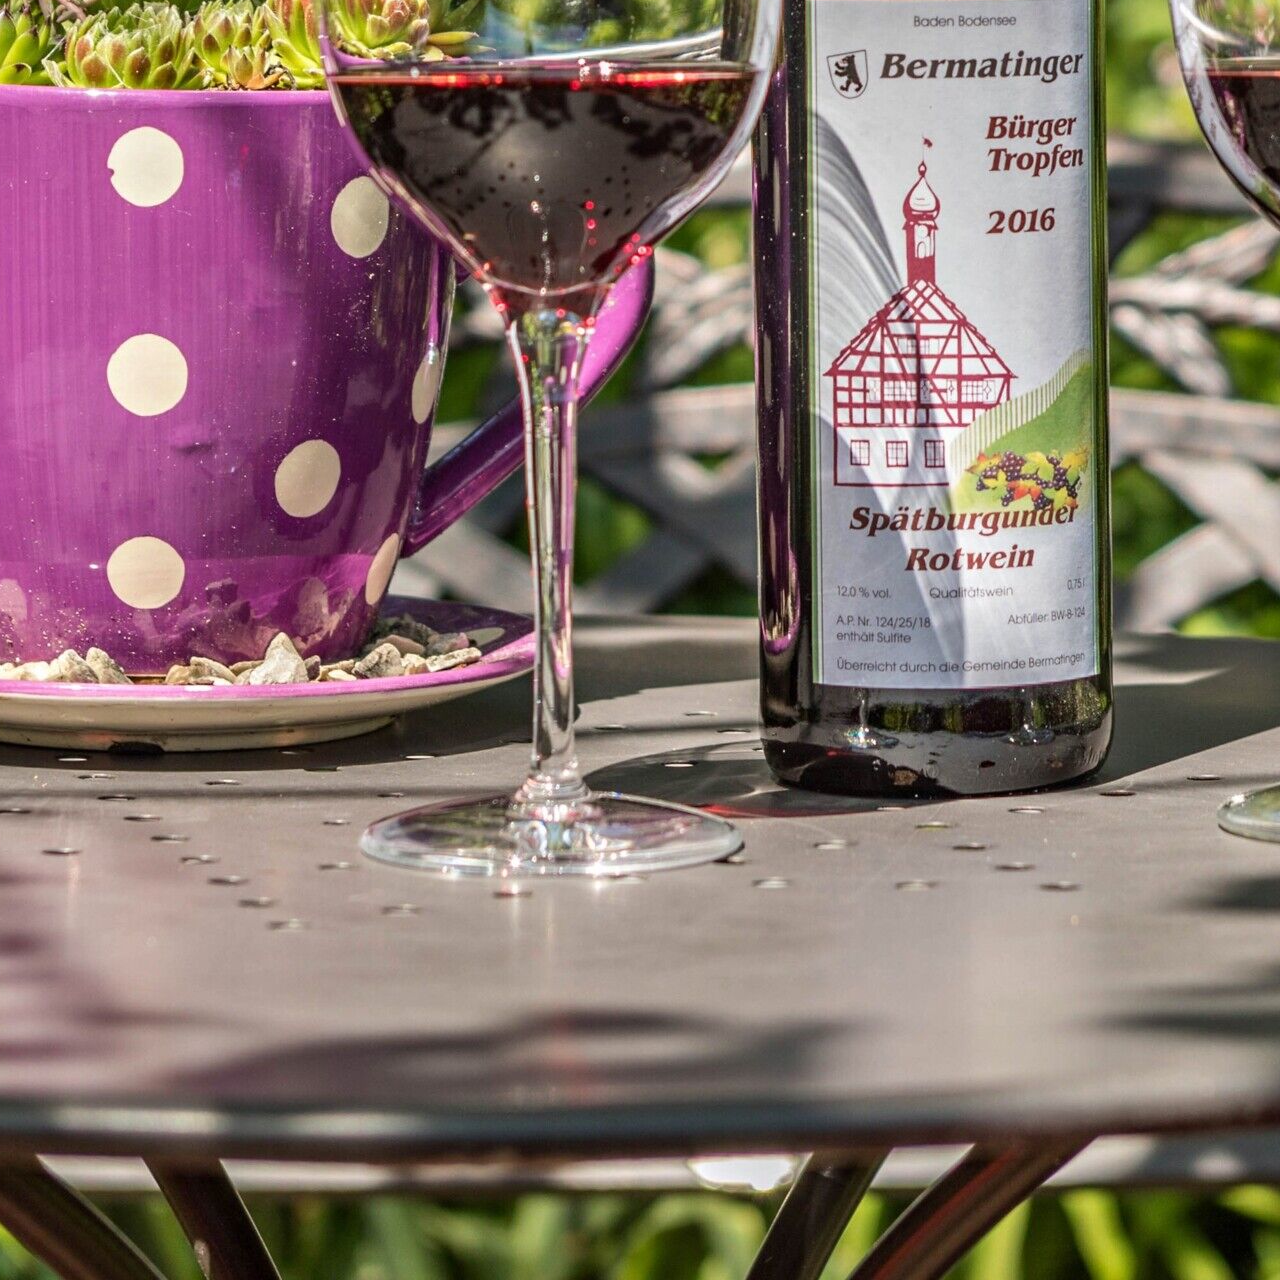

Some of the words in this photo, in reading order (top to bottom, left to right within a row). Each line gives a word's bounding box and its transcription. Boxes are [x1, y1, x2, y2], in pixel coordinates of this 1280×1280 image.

[913, 15, 955, 27] Baden
[958, 15, 1017, 27] Bodensee
[879, 50, 1084, 83] Bermatinger
[985, 114, 1078, 145] Bürger
[987, 144, 1084, 177] Tropfen
[985, 208, 1056, 234] 2016
[849, 502, 1078, 537] Spätburgunder
[904, 544, 1035, 572] Rotwein
[872, 587, 892, 599] vol.
[929, 585, 1014, 599] Qualitätswein
[875, 616, 932, 630] 124/25/18
[836, 631, 875, 643] enthält
[877, 632, 912, 644] Sulfite
[837, 656, 897, 672] Überreicht
[900, 662, 936, 673] durch
[938, 661, 960, 673] die
[962, 659, 1026, 672] Gemeinde
[1028, 652, 1086, 668] Bermatingen
